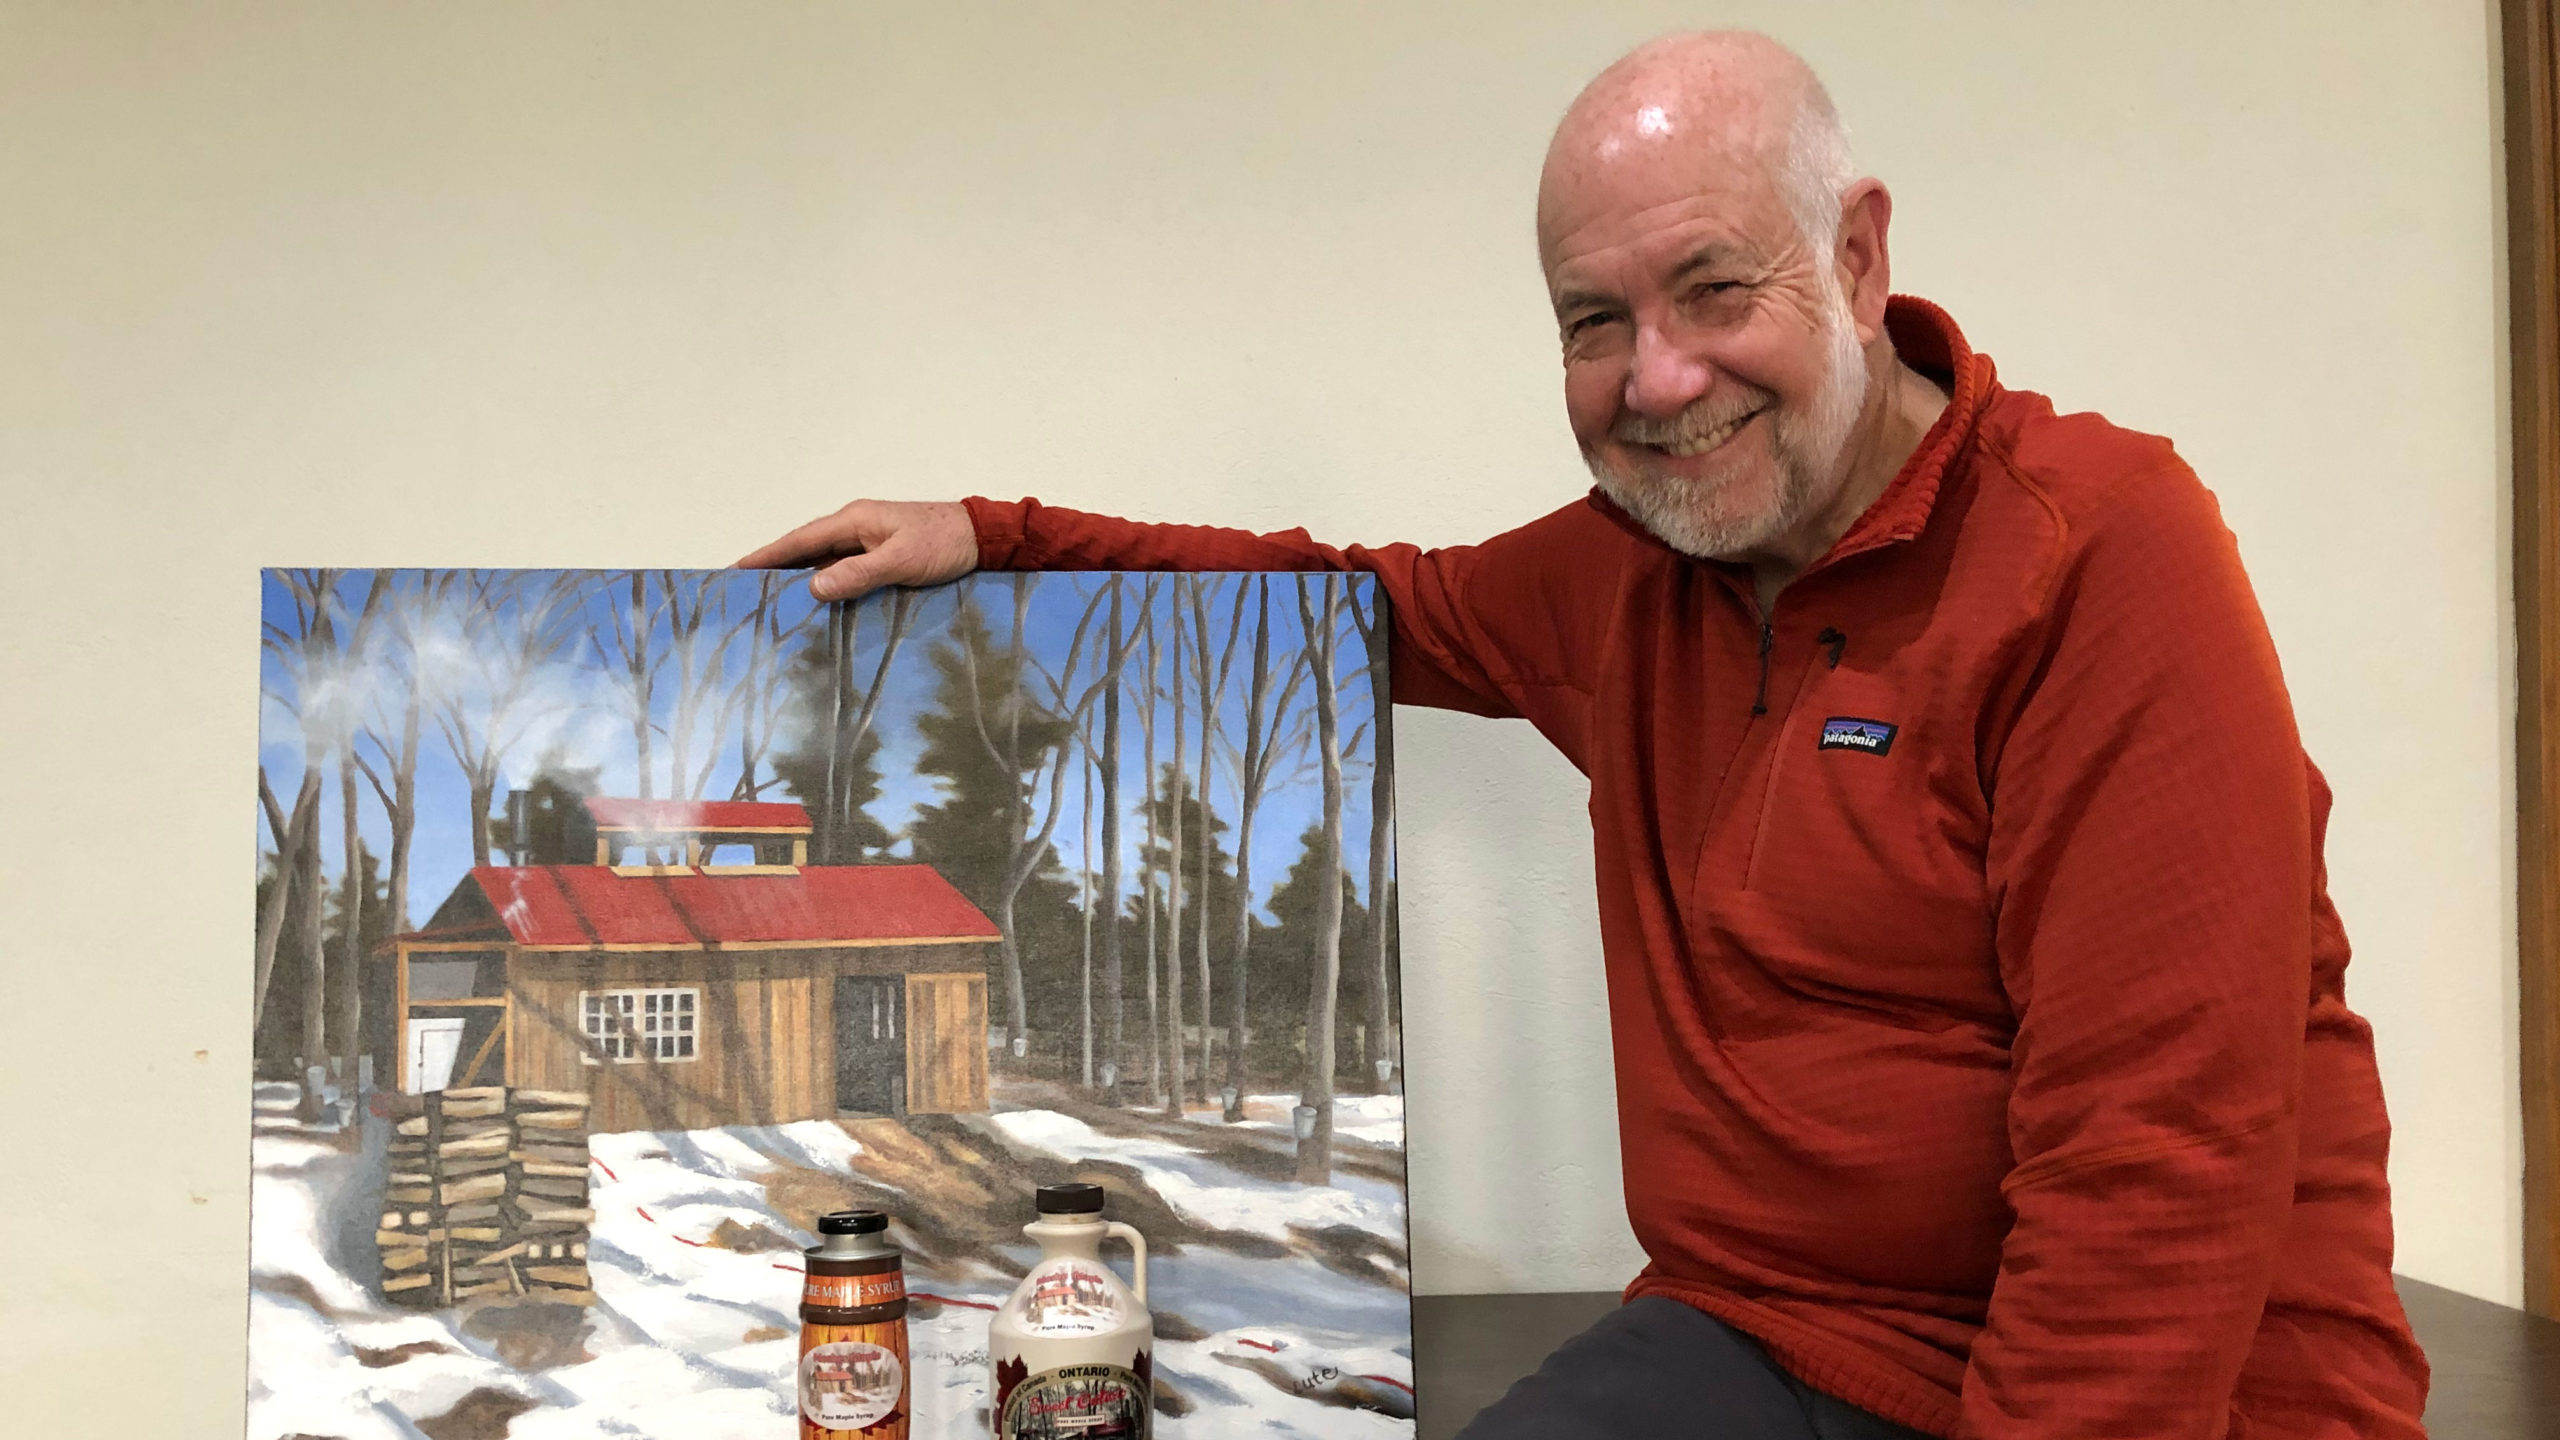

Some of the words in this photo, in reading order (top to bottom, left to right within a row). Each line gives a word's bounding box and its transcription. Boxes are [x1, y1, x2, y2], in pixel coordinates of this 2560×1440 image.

[1823, 732, 1878, 748] patagonia
[867, 1280, 900, 1297] SYRUP
[1058, 1366, 1110, 1379] ONTARIO
